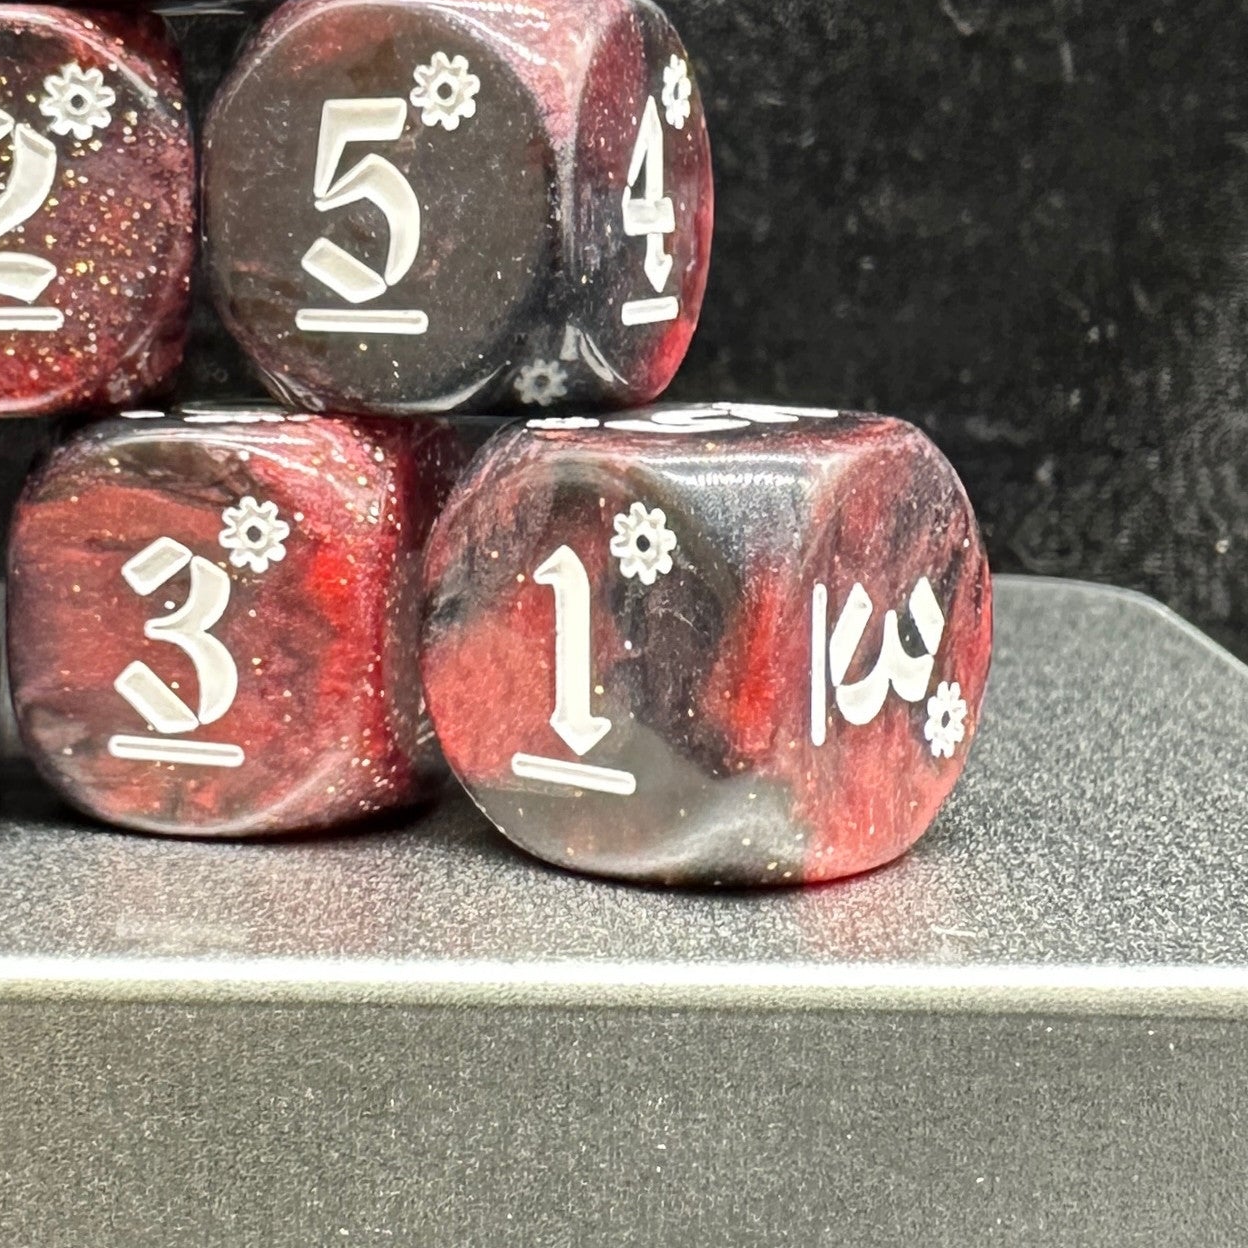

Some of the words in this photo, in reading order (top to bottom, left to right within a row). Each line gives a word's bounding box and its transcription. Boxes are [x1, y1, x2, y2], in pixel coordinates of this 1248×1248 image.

[301, 97, 421, 304] 5
[622, 95, 675, 293] 4
[114, 536, 238, 734] 3
[533, 545, 612, 756] 1
[829, 577, 945, 725] 3
